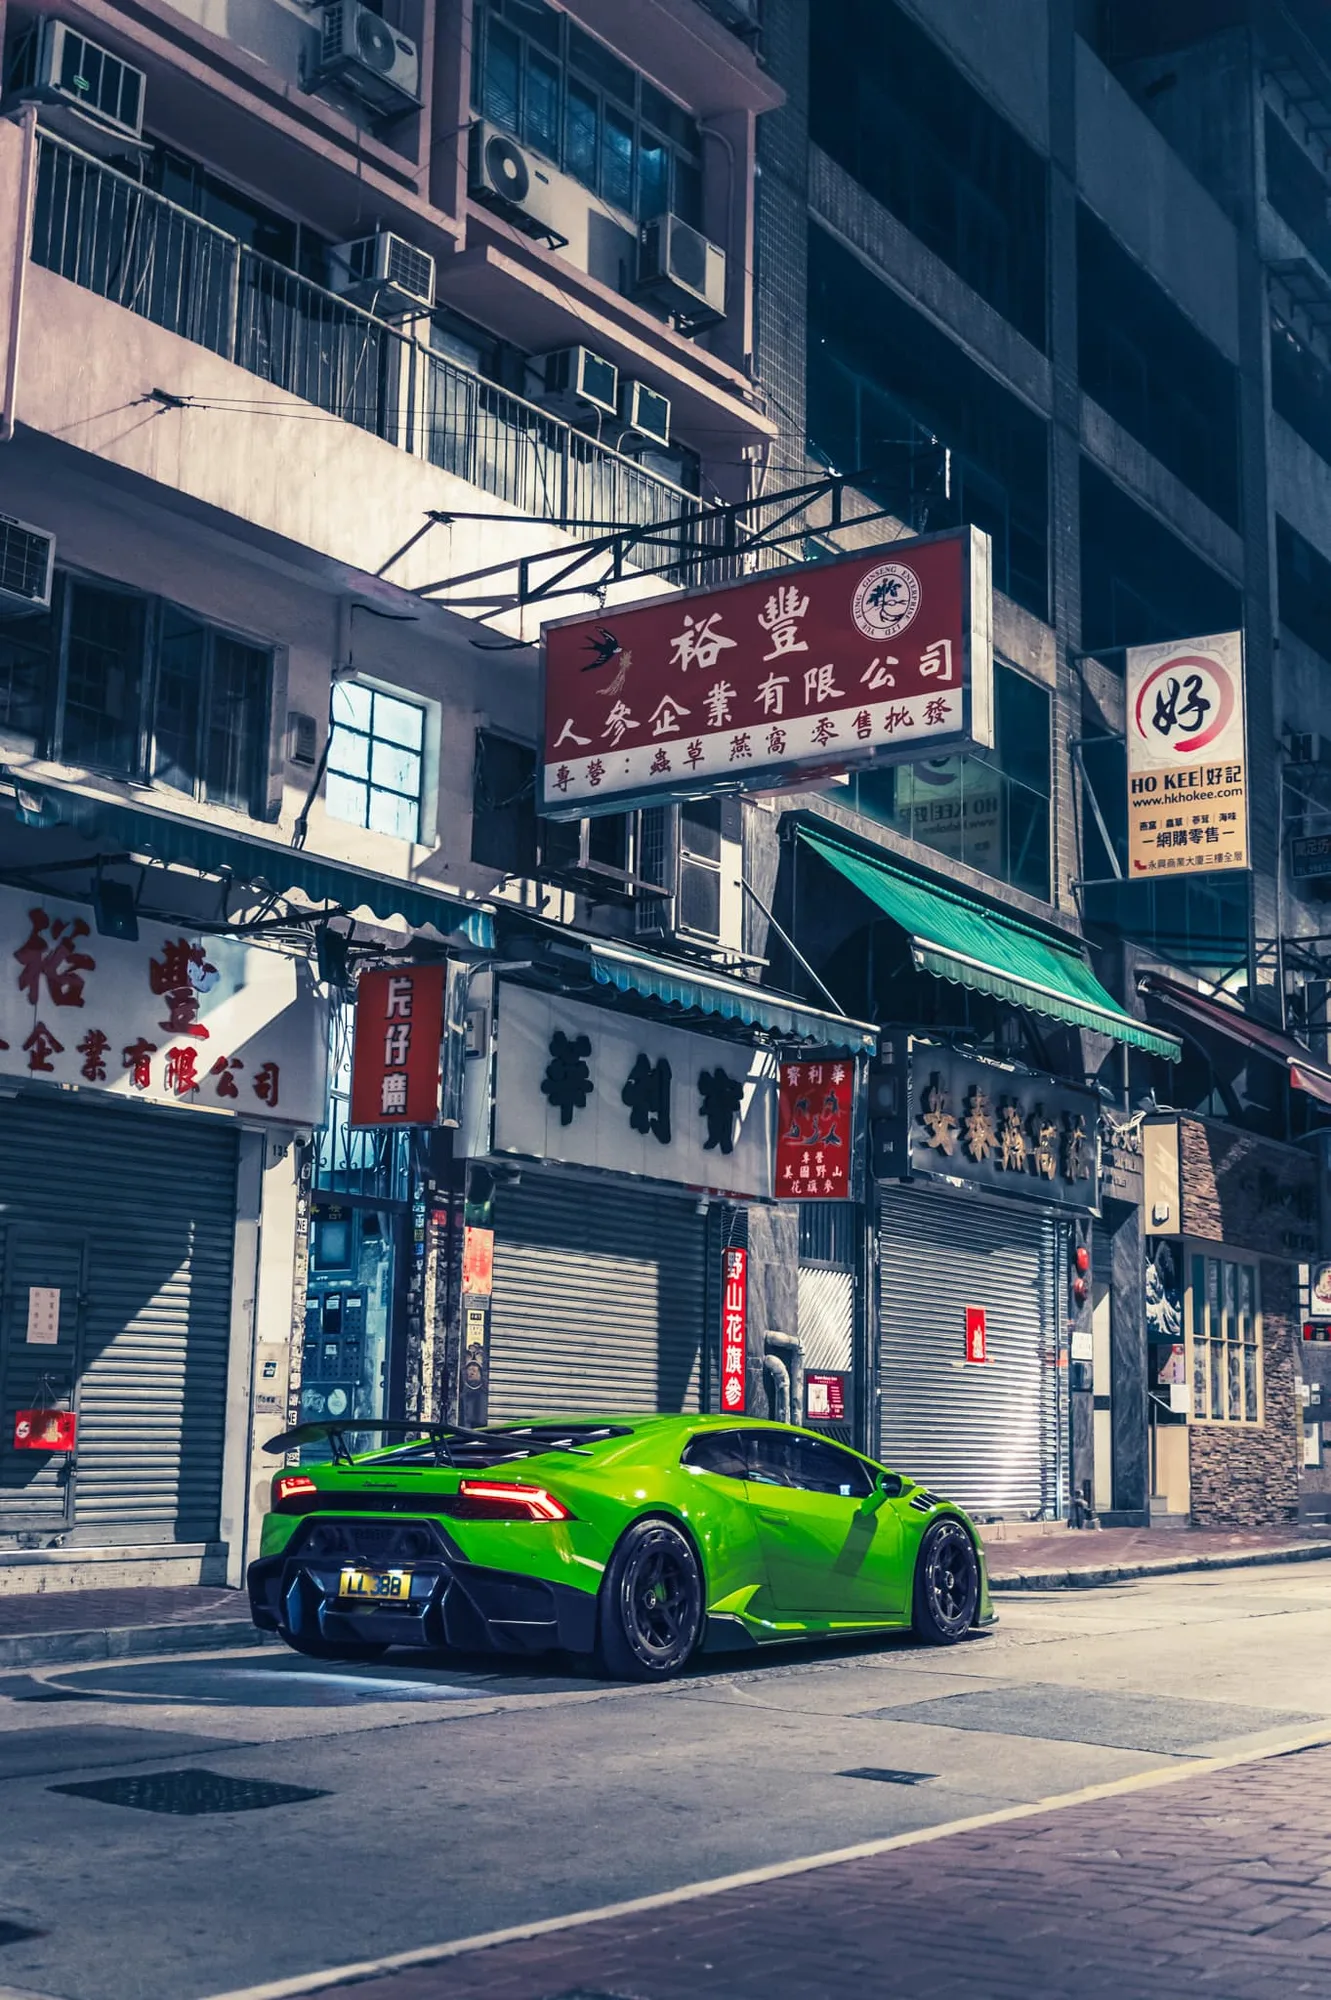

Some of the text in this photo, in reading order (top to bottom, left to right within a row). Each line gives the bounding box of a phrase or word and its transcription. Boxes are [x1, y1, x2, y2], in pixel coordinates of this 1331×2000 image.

[669, 585, 810, 672] 裕豐
[862, 566, 897, 588] GINSENG
[901, 569, 918, 621] ENTERPRISE
[552, 639, 953, 749] 人參企業有限公司
[1152, 674, 1210, 735] 好
[1131, 765, 1242, 794] HO KEE 好記
[1133, 788, 1243, 808] www.hkhokee.com
[13, 907, 221, 1041] 裕豐
[0, 1021, 280, 1108] 企業有限公司
[379, 976, 414, 1115] 片仔癀
[783, 1165, 843, 1179] 美國野山
[724, 1252, 743, 1406] 野山花旗參
